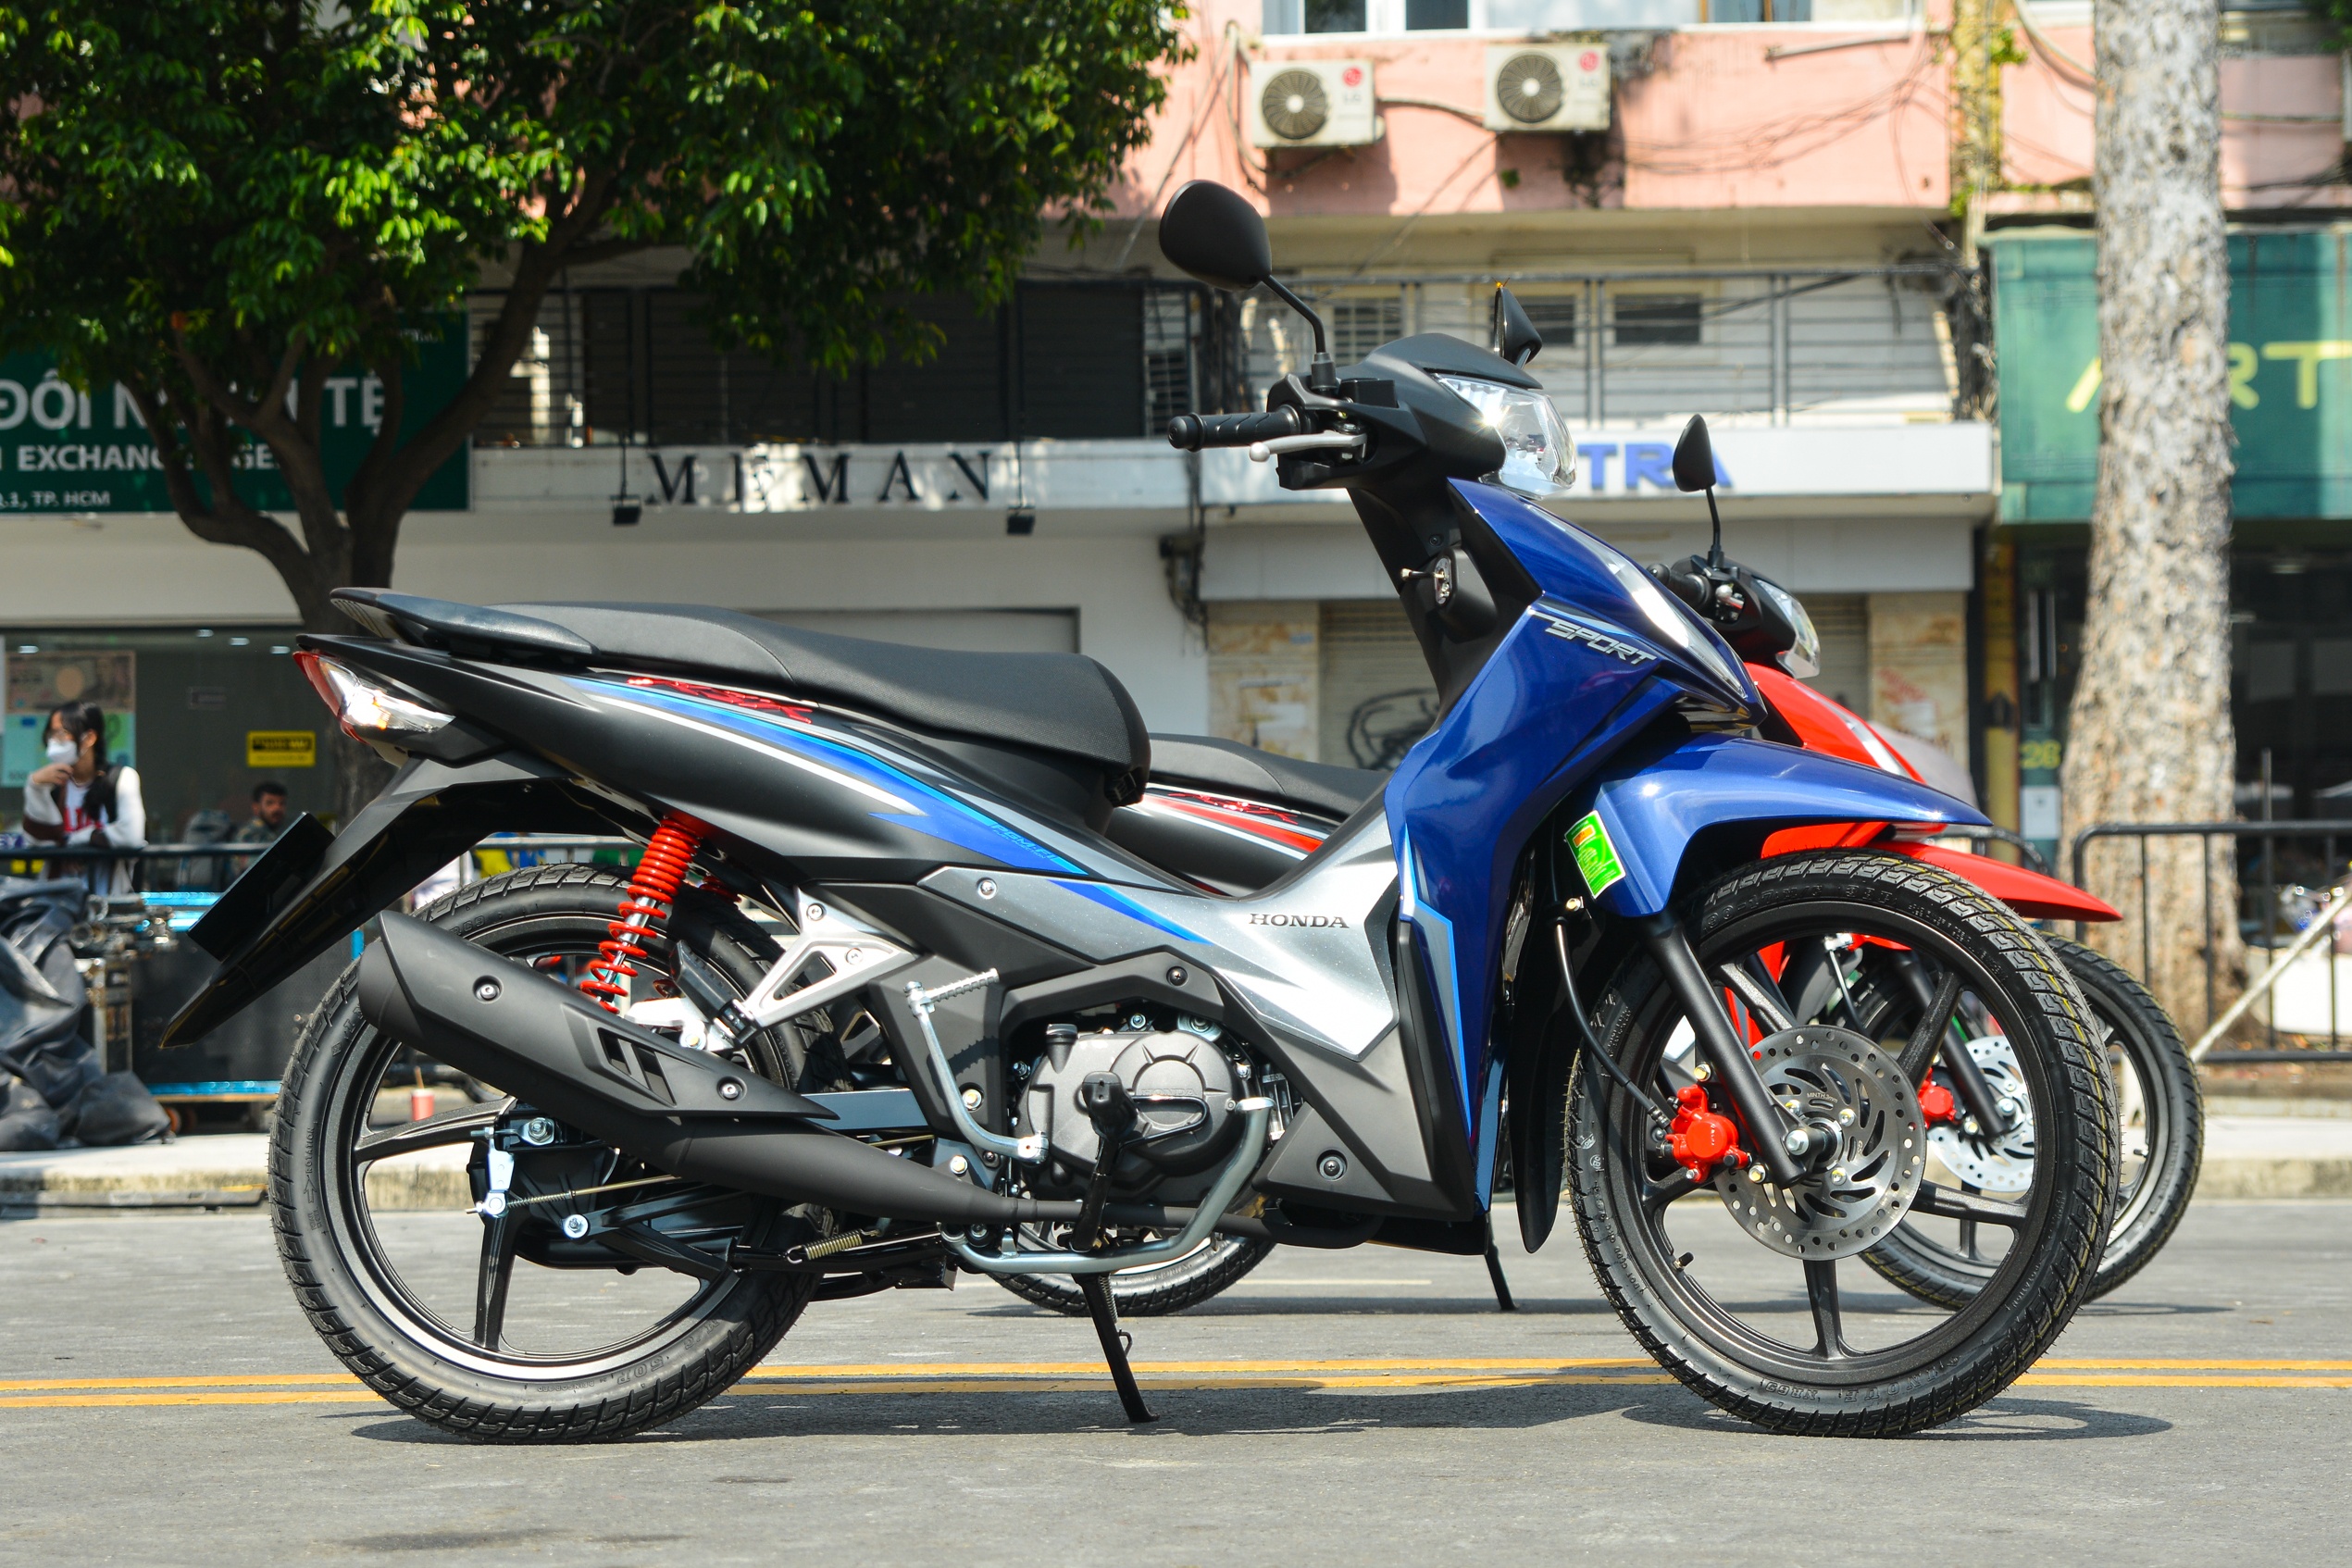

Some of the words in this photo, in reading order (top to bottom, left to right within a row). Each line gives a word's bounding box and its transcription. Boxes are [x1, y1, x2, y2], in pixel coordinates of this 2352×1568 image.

[1537, 615, 1657, 665] SPORT
[449, 915, 486, 938] R69
[1249, 913, 1350, 928] HONDA
[1140, 1088, 1198, 1098] HONDA
[305, 1126, 314, 1174] ROTATION
[1842, 1367, 1940, 1402] INOUE
